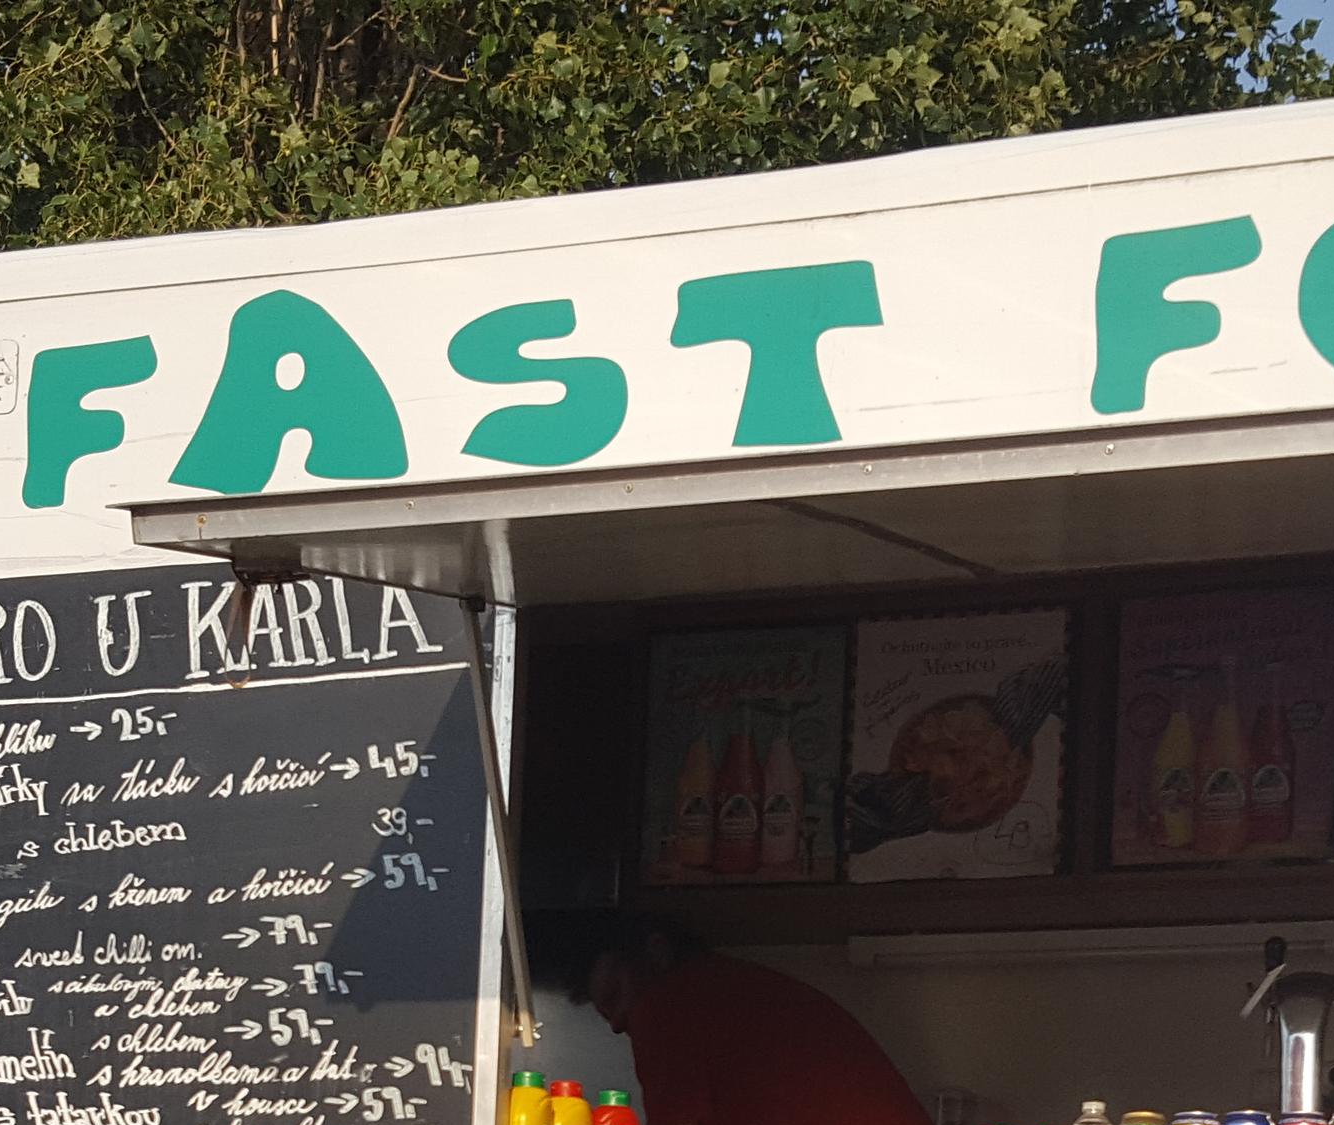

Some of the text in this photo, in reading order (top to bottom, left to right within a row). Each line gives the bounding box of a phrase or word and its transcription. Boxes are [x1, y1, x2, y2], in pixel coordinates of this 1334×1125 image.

[22, 260, 884, 509] FAST
[94, 590, 152, 677] U
[181, 575, 444, 680] KARLA
[922, 657, 996, 677] Mexico
[111, 705, 178, 742] 25,-
[60, 781, 105, 806] na
[112, 757, 200, 803] tácku
[208, 772, 234, 799] s
[17, 840, 40, 860] s
[53, 819, 187, 856] chlebem
[78, 894, 98, 913] s
[108, 872, 193, 909] křenem
[207, 885, 238, 905] a
[241, 861, 335, 902] hořčicí
[93, 932, 154, 967] chilli
[94, 988, 221, 1019] a chlebem
[91, 1034, 111, 1052] s
[117, 1020, 218, 1054] chlebem
[86, 1065, 113, 1086] s
[221, 1087, 318, 1117] housce
